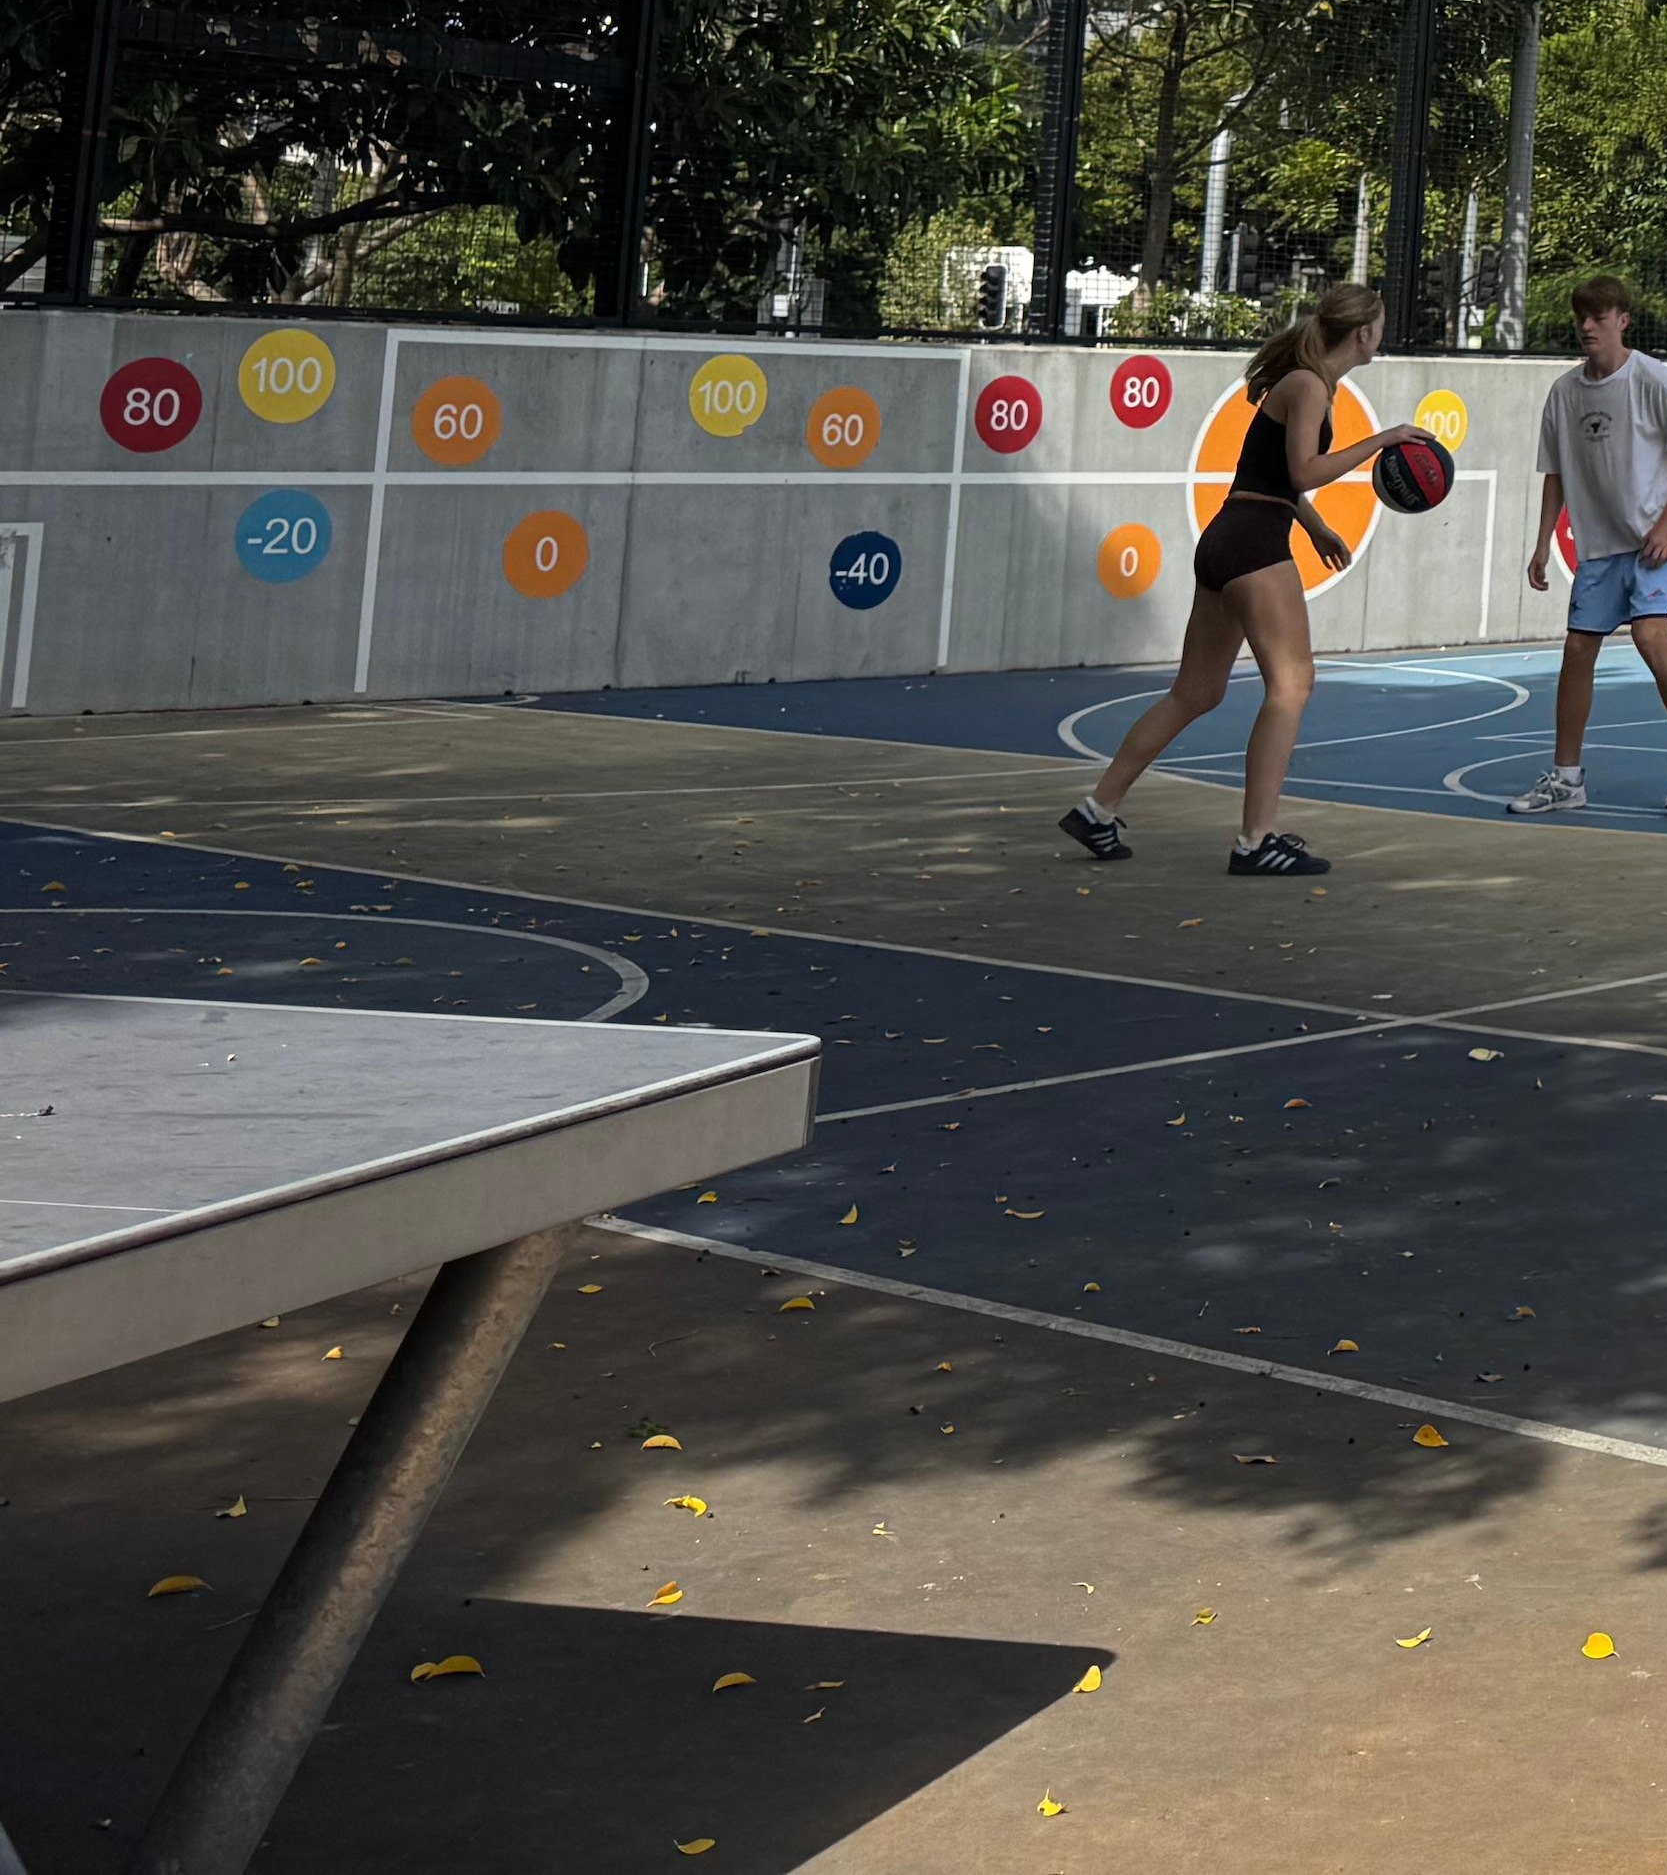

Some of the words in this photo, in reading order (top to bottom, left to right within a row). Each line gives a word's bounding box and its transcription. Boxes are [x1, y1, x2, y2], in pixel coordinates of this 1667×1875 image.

[252, 356, 323, 395] 100
[1122, 376, 1161, 409] 80
[122, 387, 181, 427] 80
[699, 379, 757, 415] 100
[433, 403, 484, 440] 60
[822, 413, 864, 447] 60
[989, 399, 1030, 432] 80
[1421, 410, 1461, 440] 100
[247, 517, 318, 556] -20
[535, 536, 559, 573] 0
[834, 552, 890, 586] -40
[1120, 546, 1139, 578] 0
